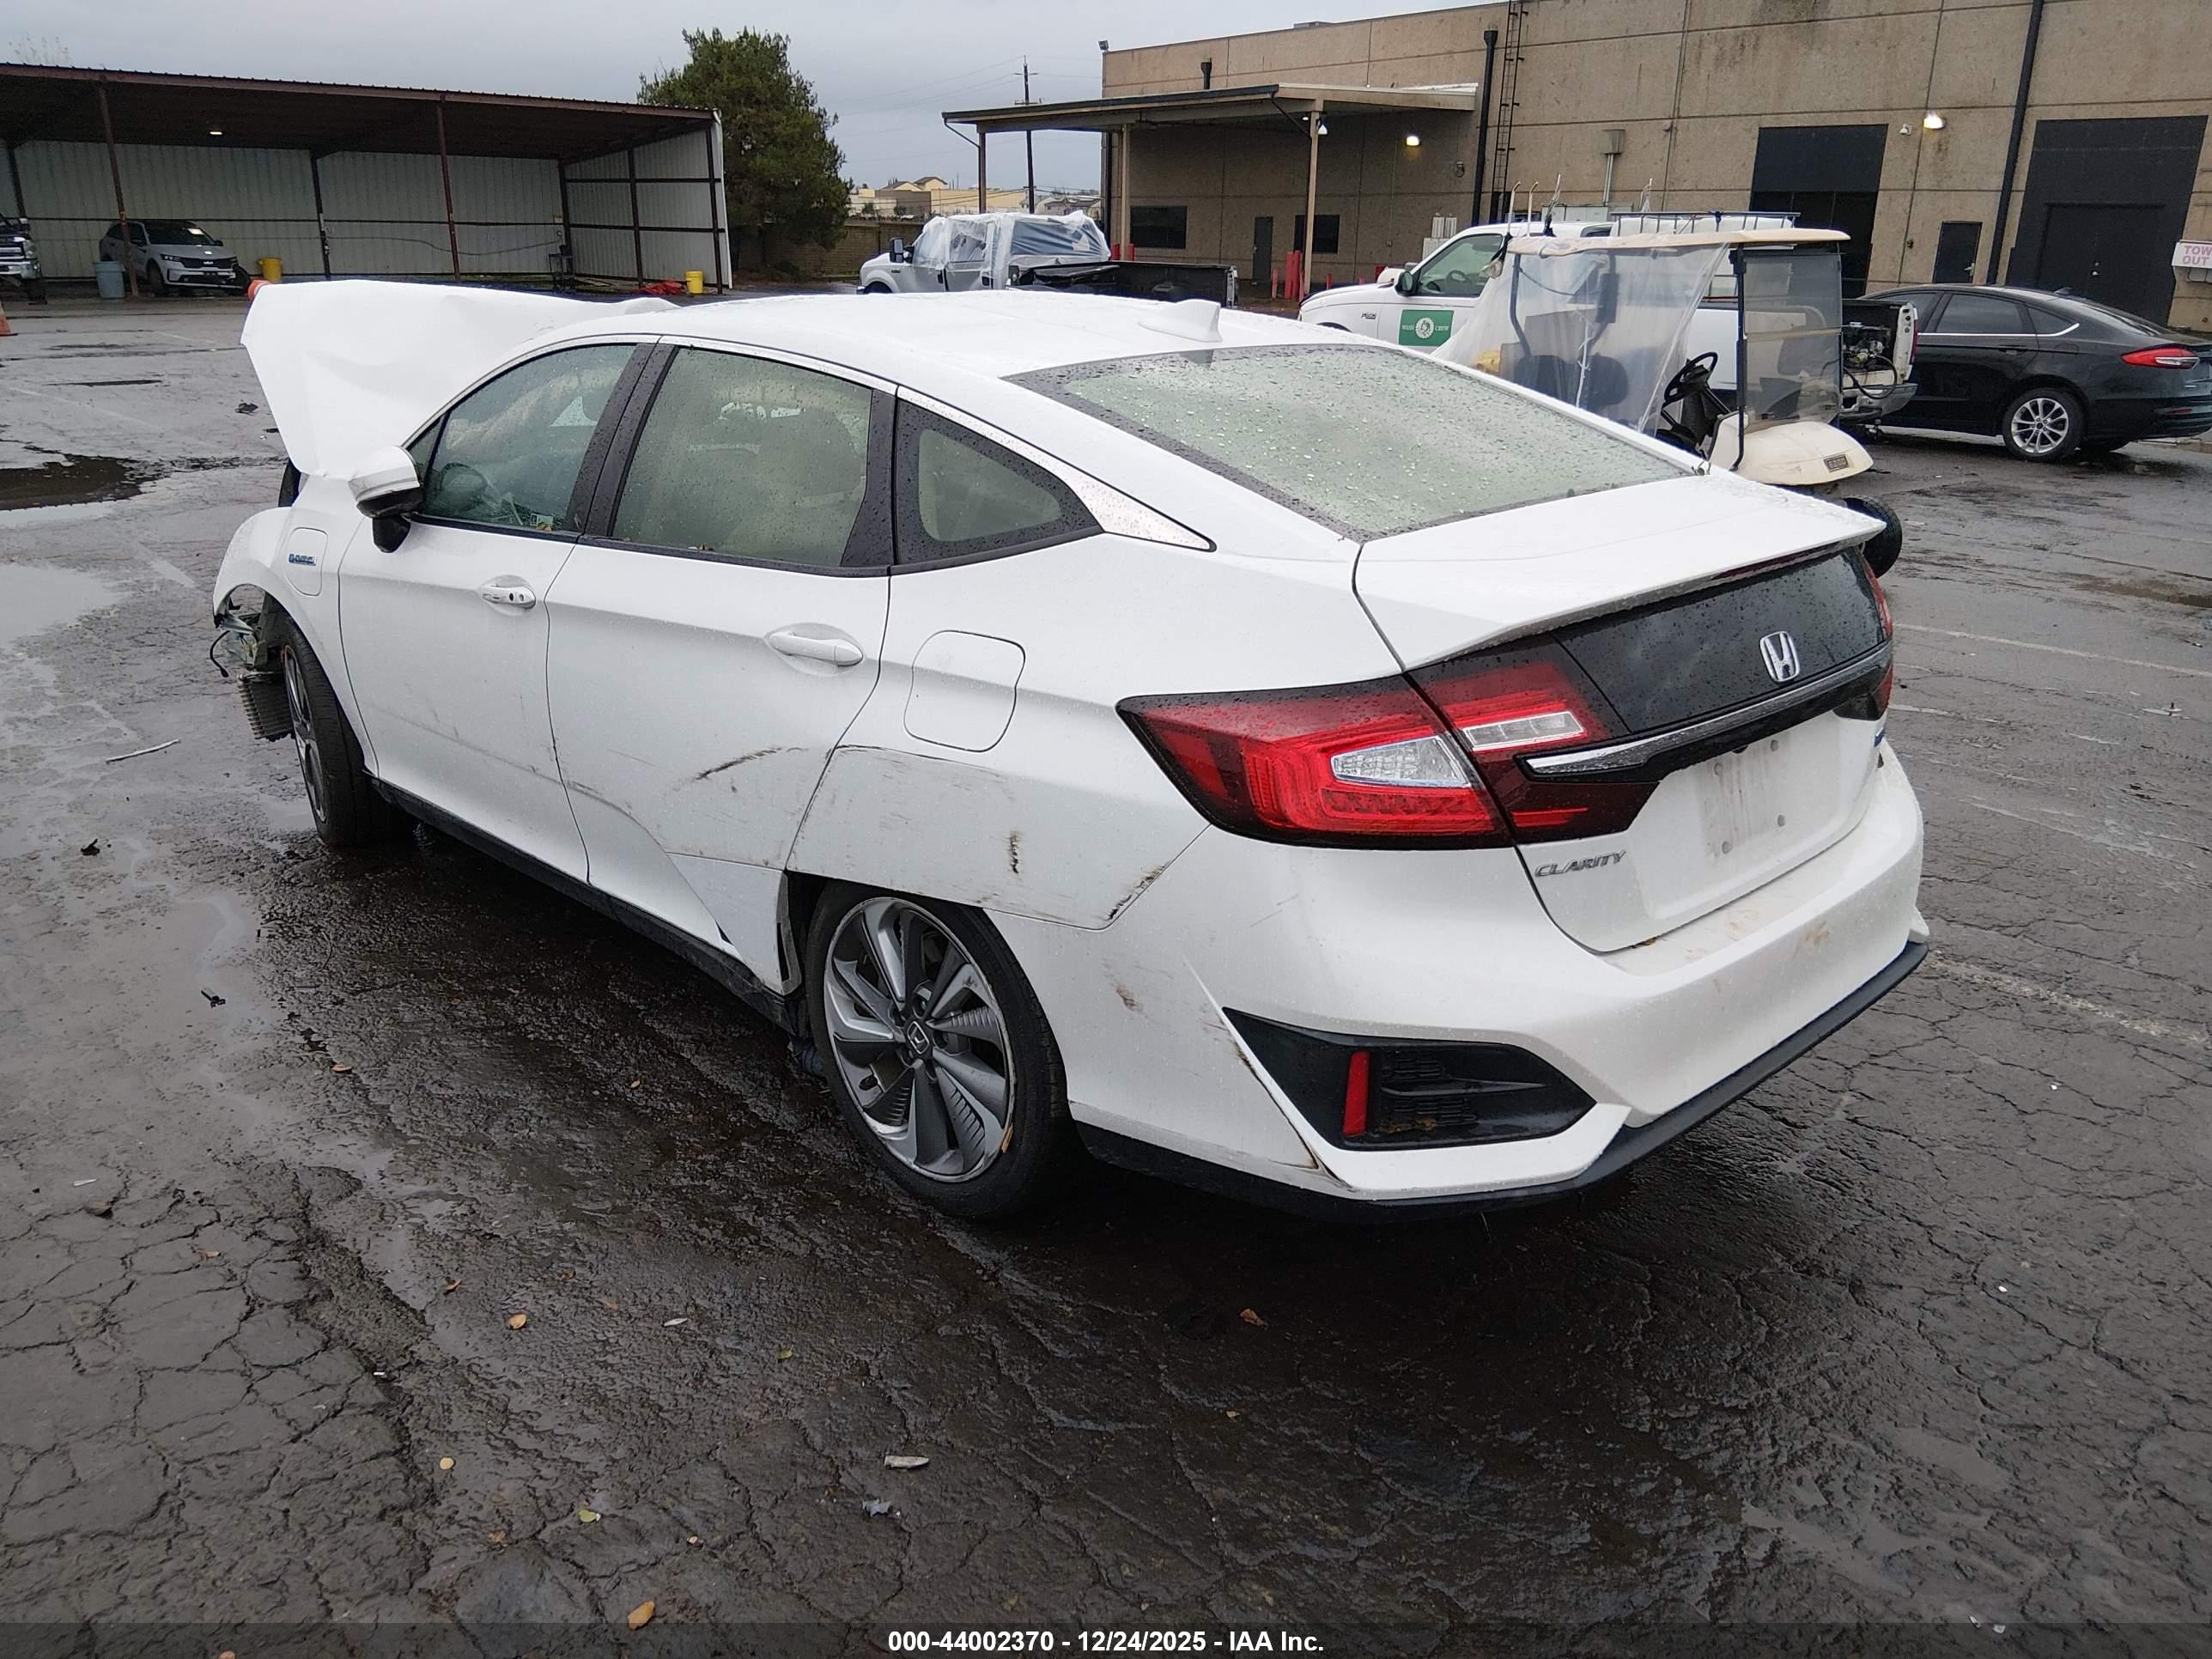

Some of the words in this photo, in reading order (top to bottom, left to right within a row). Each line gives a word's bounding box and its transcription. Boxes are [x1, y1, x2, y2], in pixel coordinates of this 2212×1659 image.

[2184, 246, 2212, 255] TOW
[2183, 256, 2209, 265] OUT
[1534, 849, 1626, 877] CLARITY
